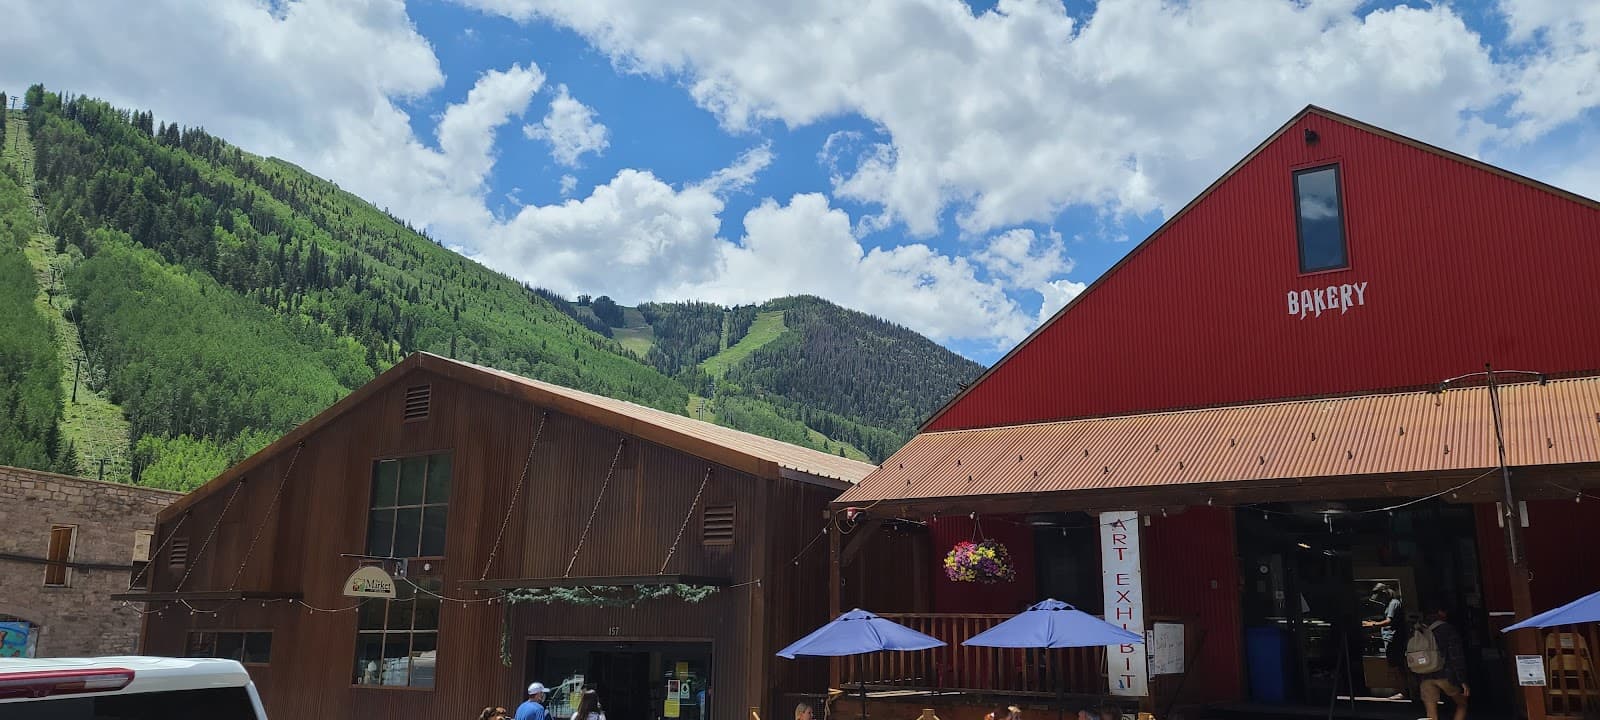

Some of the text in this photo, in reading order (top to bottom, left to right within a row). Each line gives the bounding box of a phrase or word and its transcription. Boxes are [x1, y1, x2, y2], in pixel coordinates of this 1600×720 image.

[1287, 281, 1368, 320] BAKERY
[1112, 518, 1128, 561] ART
[366, 579, 391, 590] Market
[608, 626, 620, 636] 157
